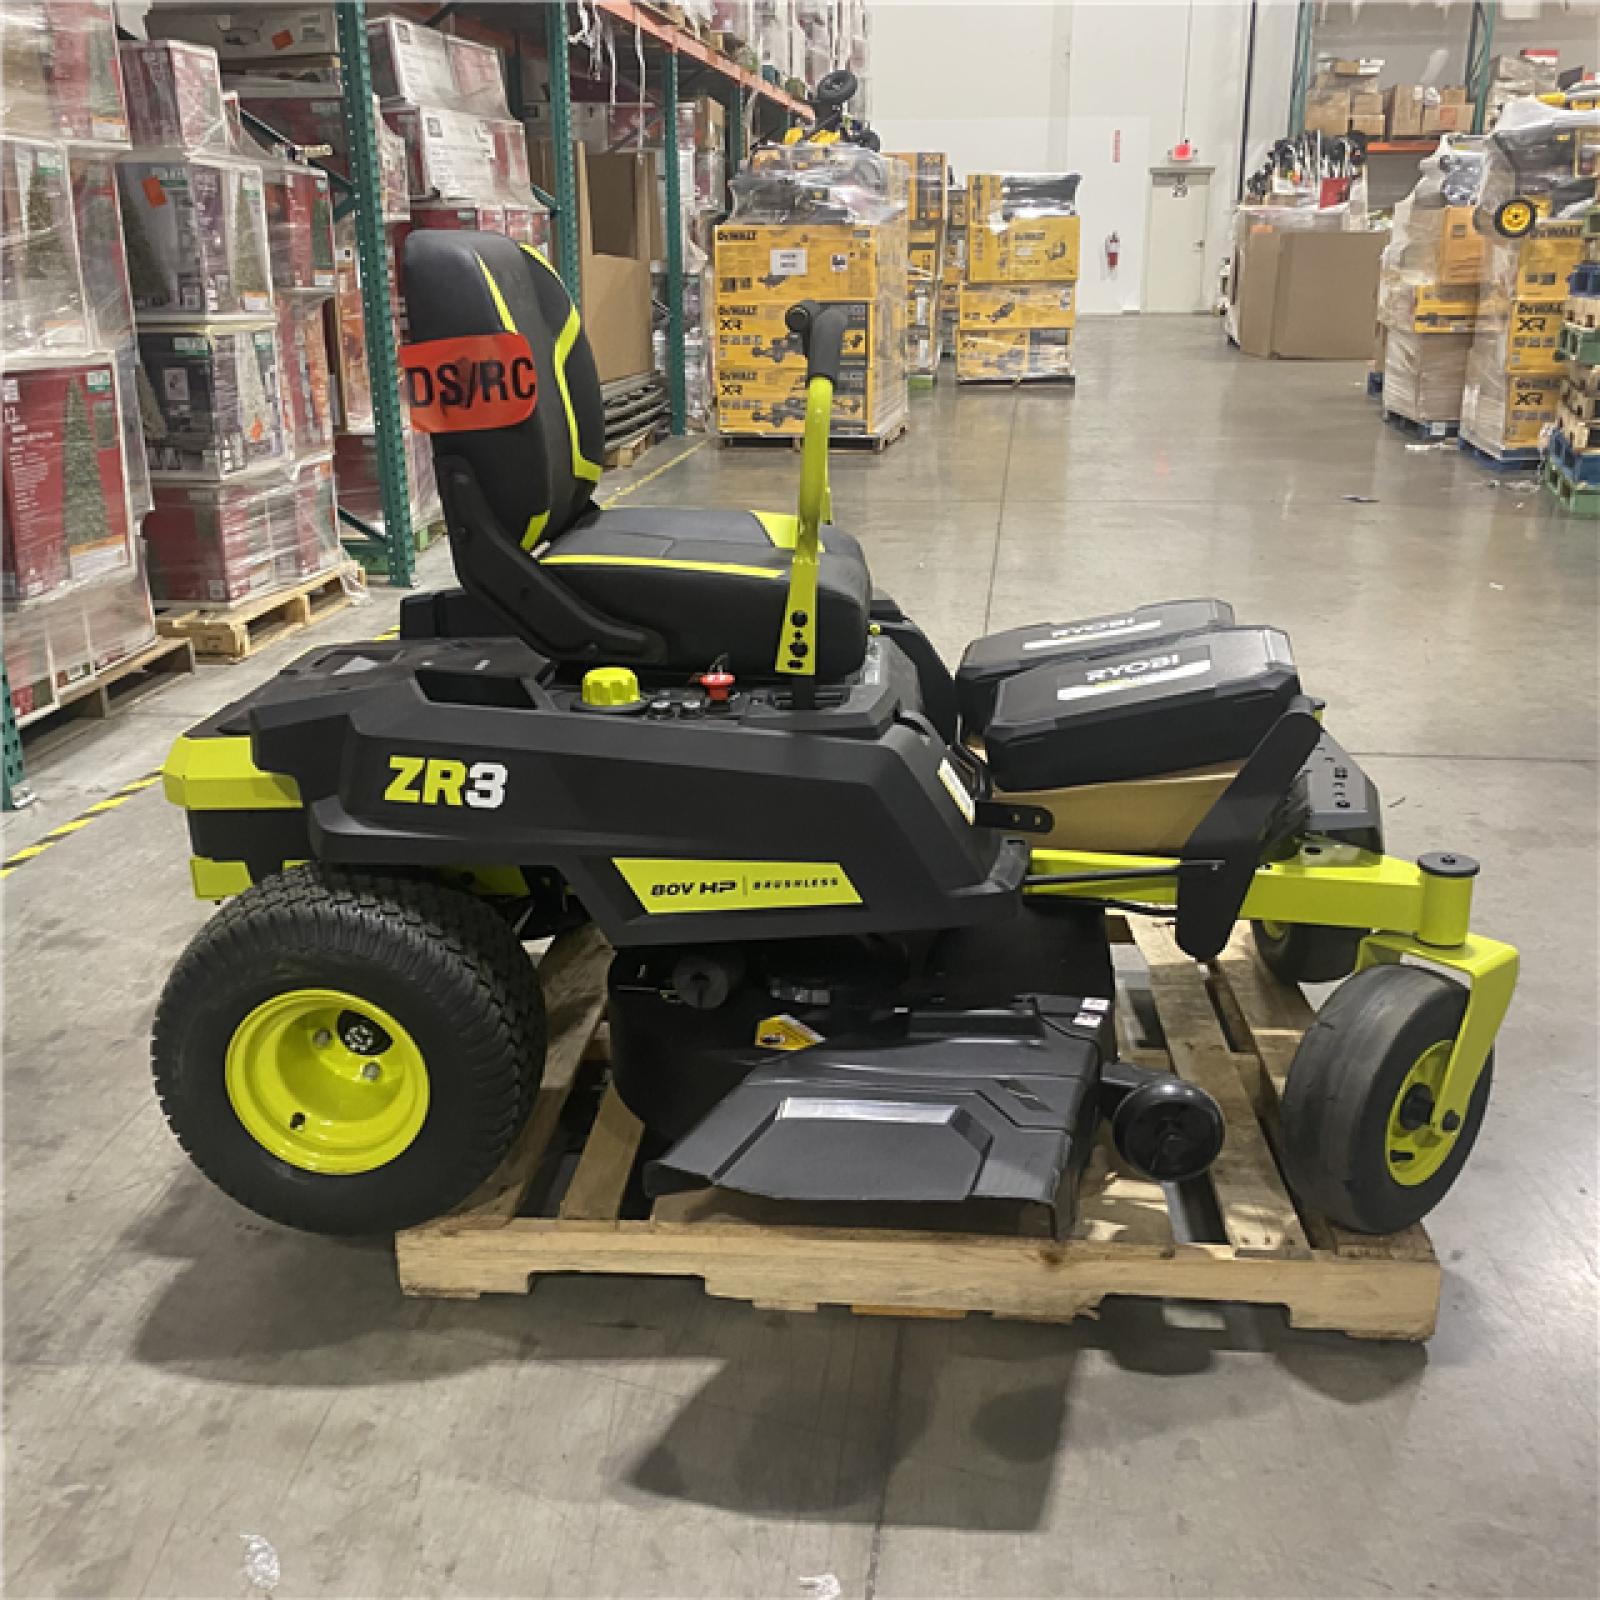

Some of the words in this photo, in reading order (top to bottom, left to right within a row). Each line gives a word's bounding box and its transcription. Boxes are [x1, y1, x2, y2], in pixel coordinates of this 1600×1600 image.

[720, 319, 742, 331] XR
[1519, 317, 1546, 332] XR
[406, 357, 536, 409] DS/RC
[721, 384, 743, 396] XR
[1515, 392, 1544, 406] XR
[1085, 653, 1181, 682] RYOBI
[384, 754, 508, 809] ZR3
[651, 882, 695, 896] 80V
[700, 879, 736, 894] HP
[754, 877, 839, 890] BRUSHLESS
